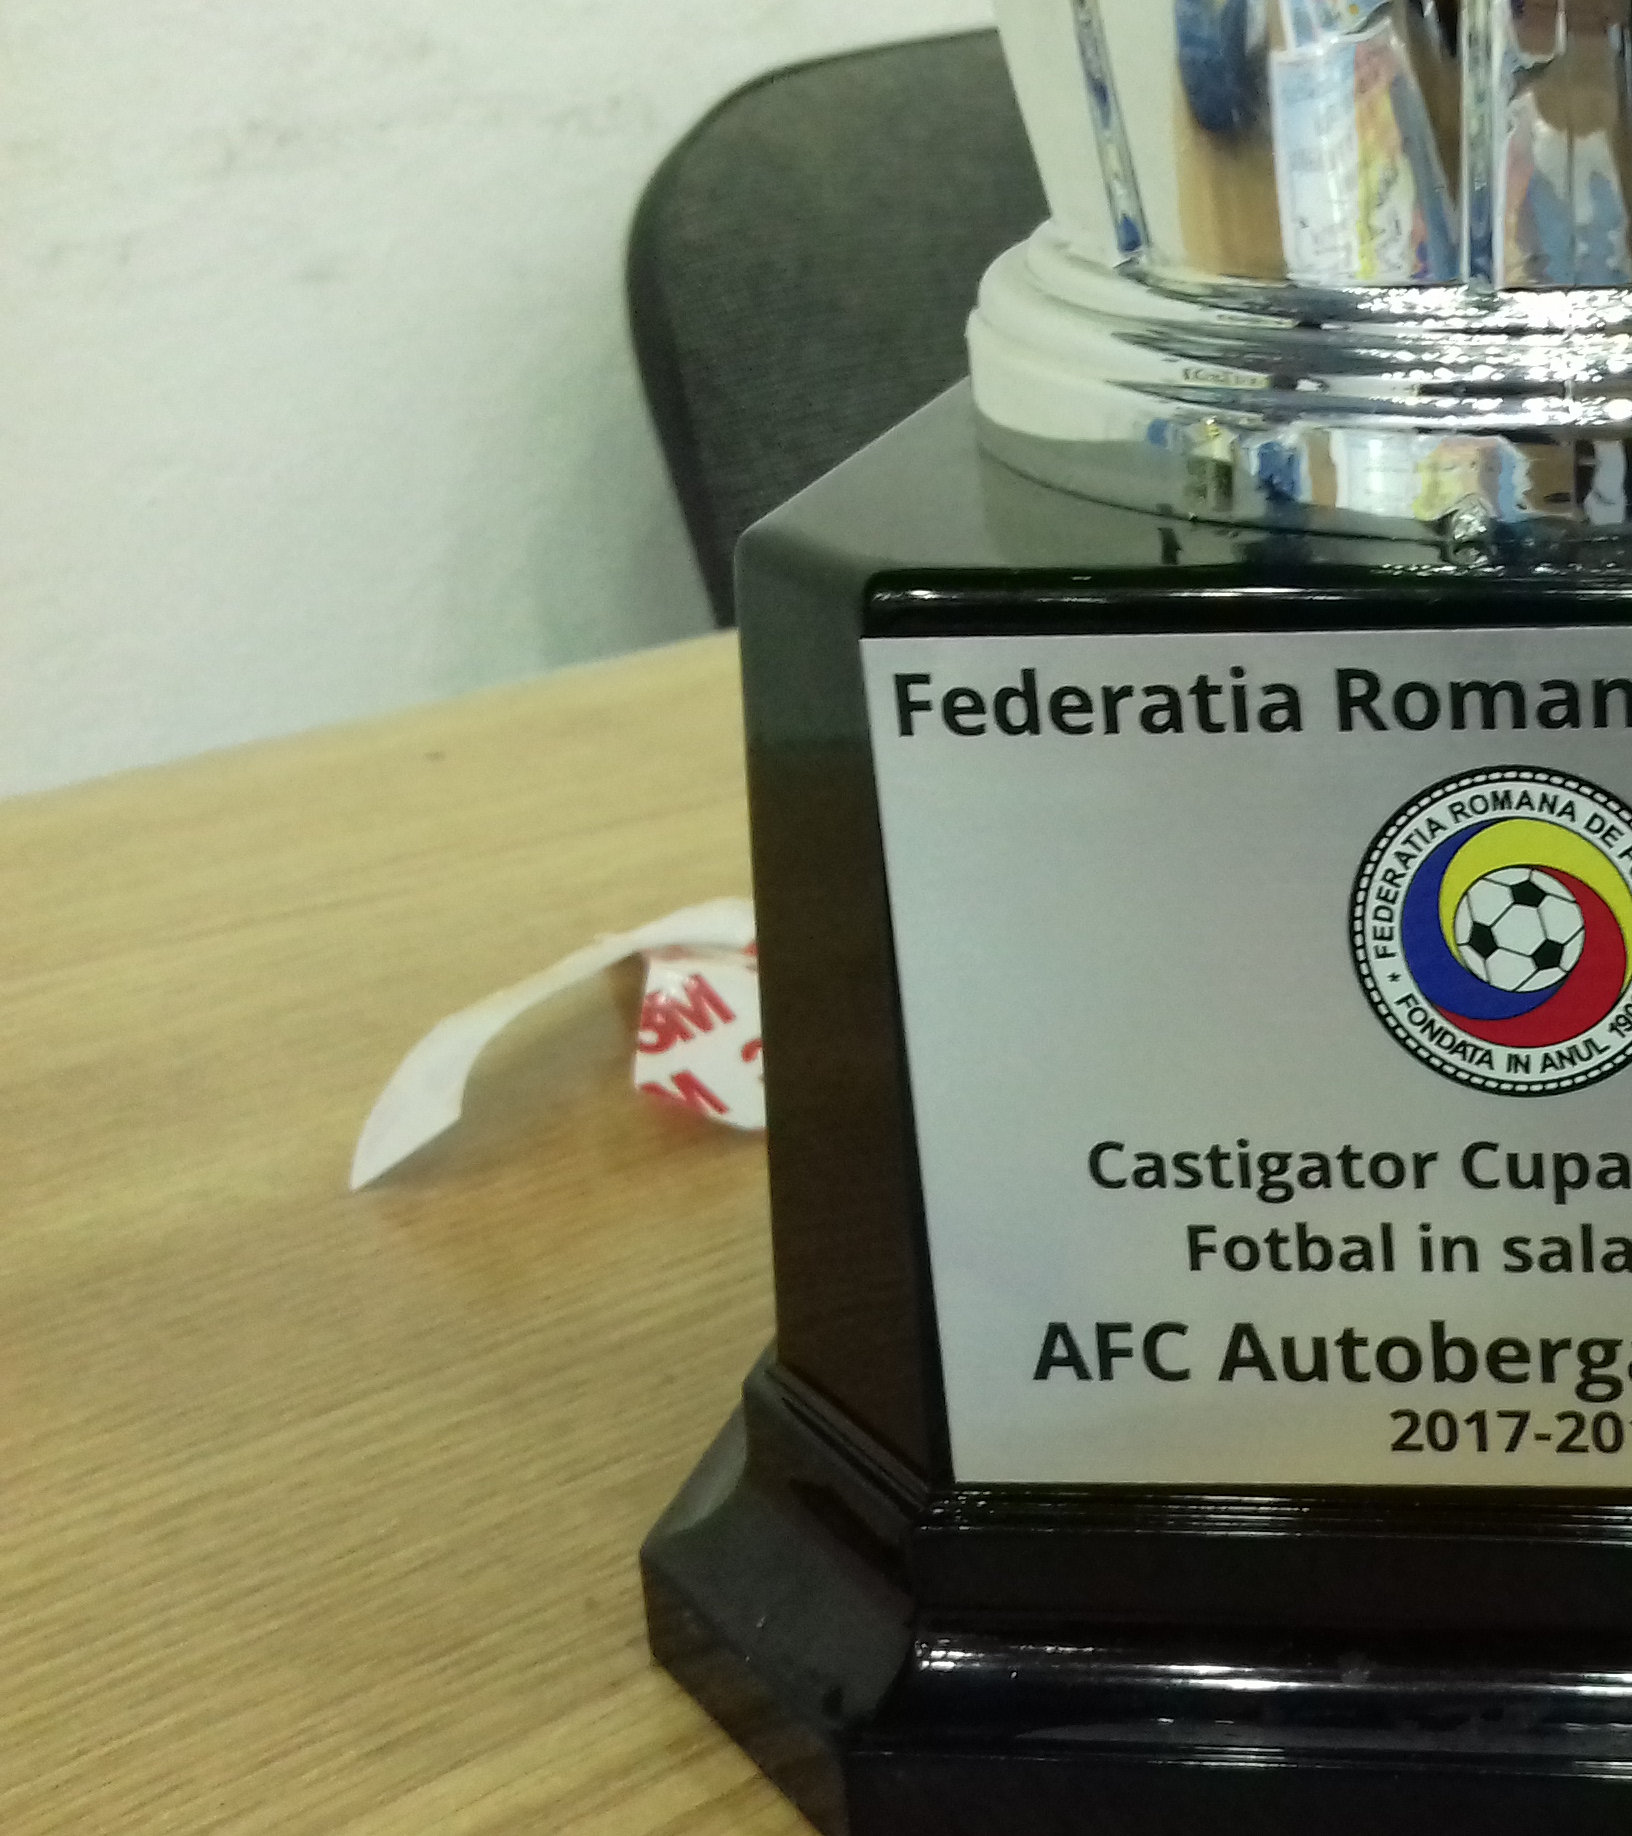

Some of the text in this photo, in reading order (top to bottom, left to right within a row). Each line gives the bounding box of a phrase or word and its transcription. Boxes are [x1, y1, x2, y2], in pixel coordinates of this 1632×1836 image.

[894, 666, 1304, 737] Federatia
[1372, 816, 1448, 961] FEDERATIA
[1448, 789, 1578, 825] ROMANA
[1583, 811, 1625, 850] DE
[1393, 992, 1496, 1072] FONDATA
[1505, 1052, 1531, 1075] IN
[1539, 1036, 1611, 1075] ANUL
[1088, 1137, 1439, 1205] Castigator
[1460, 1140, 1632, 1206] Cupa
[1186, 1221, 1395, 1273] Fotbal
[1418, 1222, 1480, 1273] in
[1032, 1321, 1191, 1383] AFC
